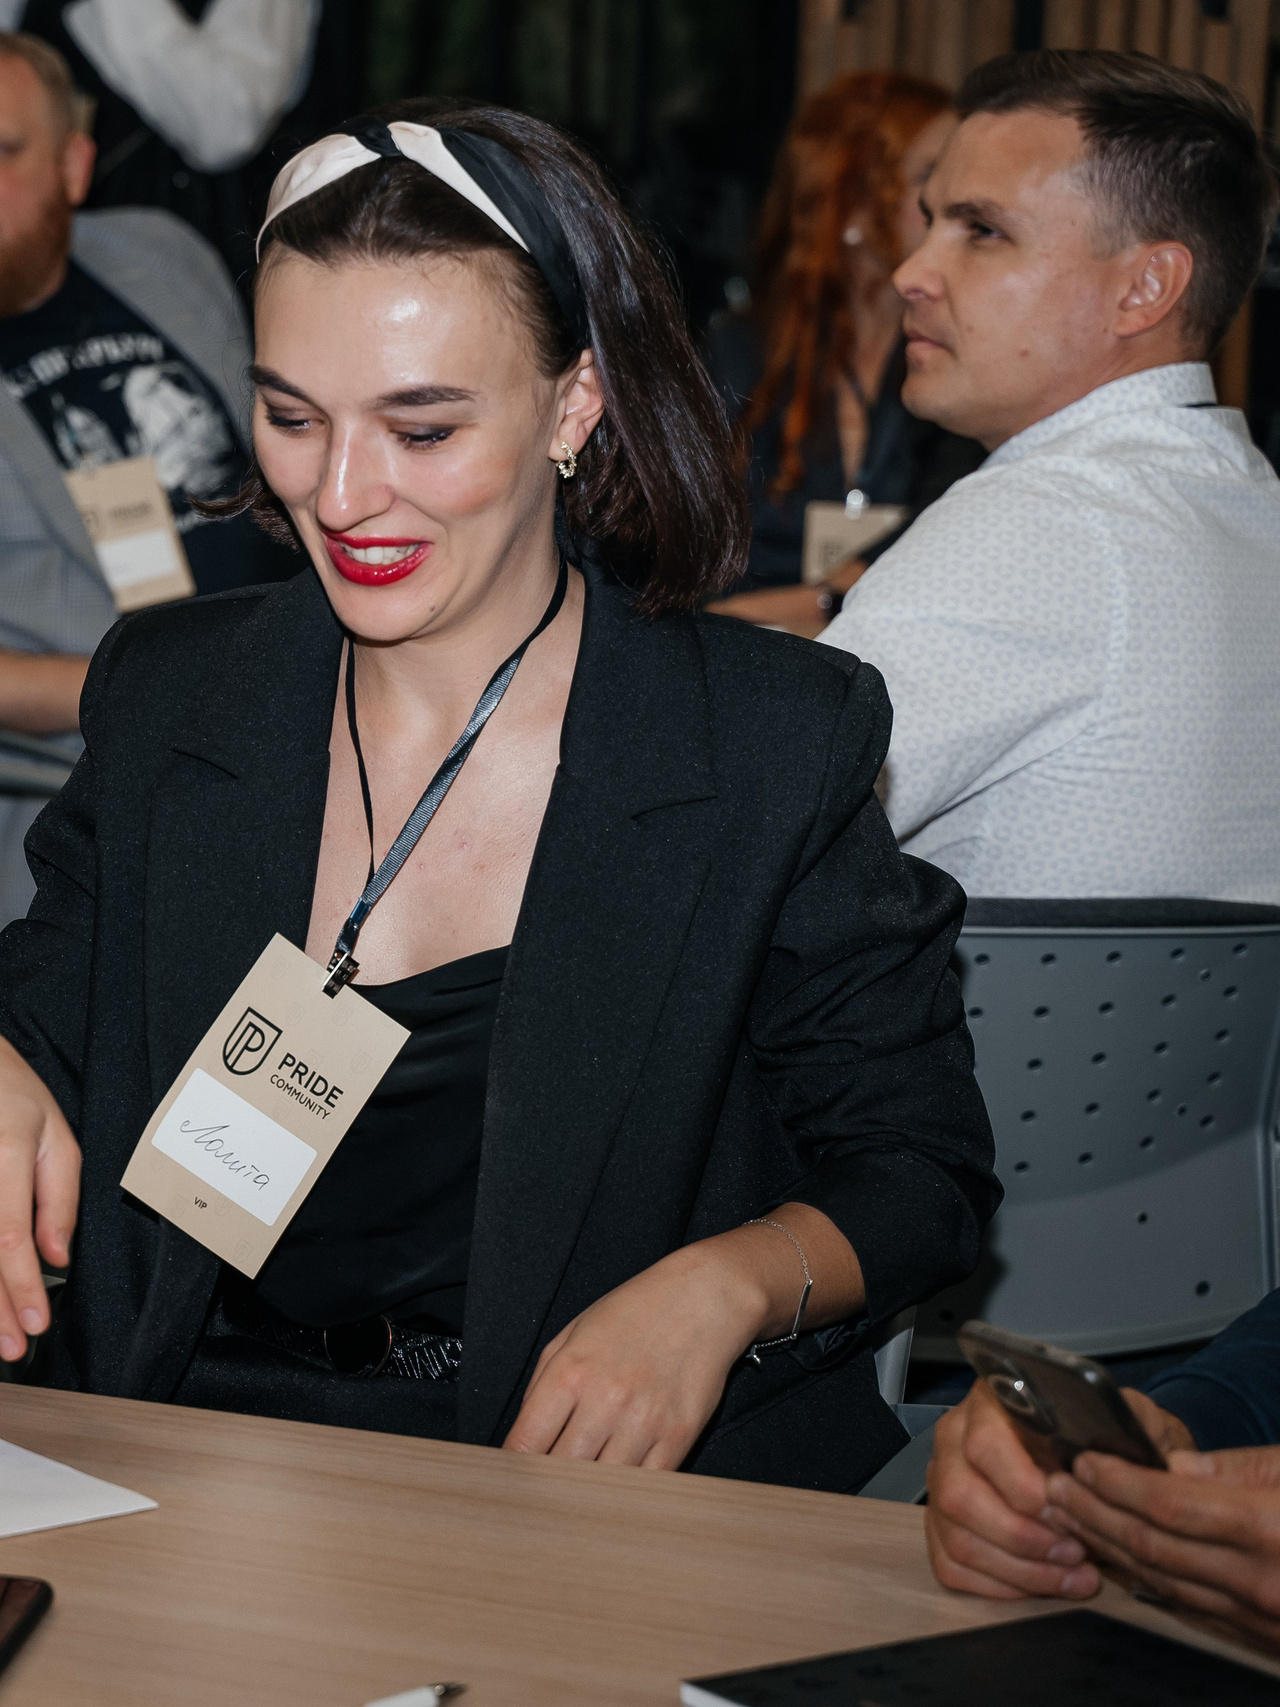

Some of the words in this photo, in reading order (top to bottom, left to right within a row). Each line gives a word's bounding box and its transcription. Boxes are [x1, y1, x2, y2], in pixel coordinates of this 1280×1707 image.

[270, 1074, 331, 1120] COMMUNITY
[277, 1052, 344, 1108] PRIDE
[180, 1120, 270, 1191] Лолита
[194, 1197, 208, 1209] VIP
